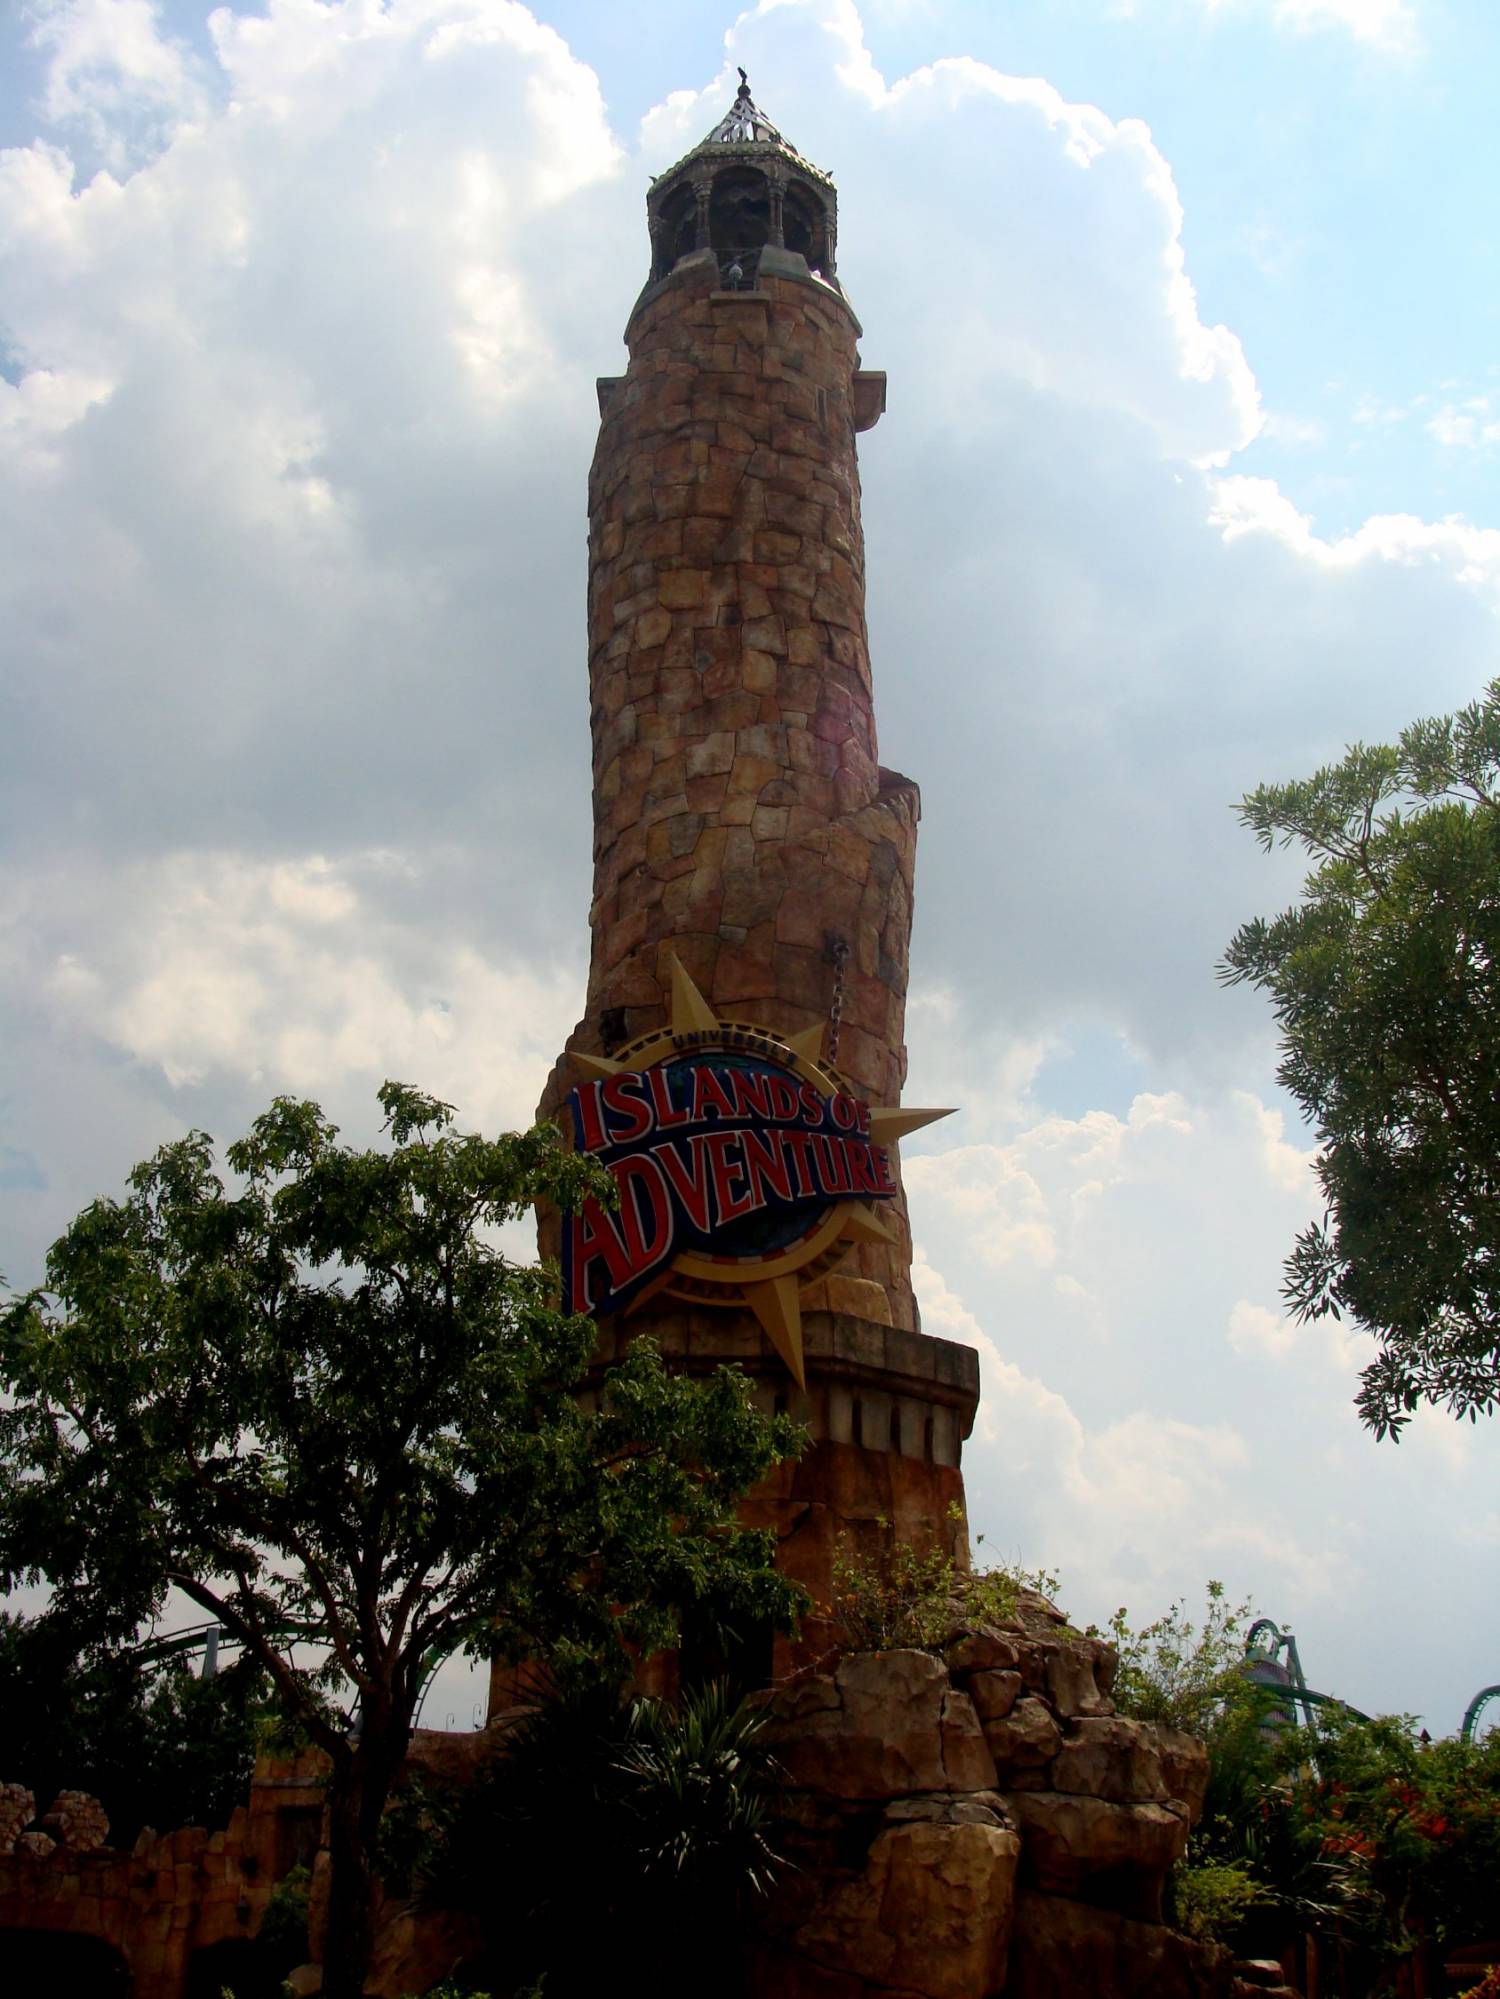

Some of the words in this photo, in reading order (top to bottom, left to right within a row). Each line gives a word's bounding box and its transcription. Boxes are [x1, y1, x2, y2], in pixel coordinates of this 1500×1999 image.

[573, 1066, 824, 1157] ISLANDS
[830, 1092, 870, 1135] OF
[572, 1129, 897, 1315] ADVENTURE
